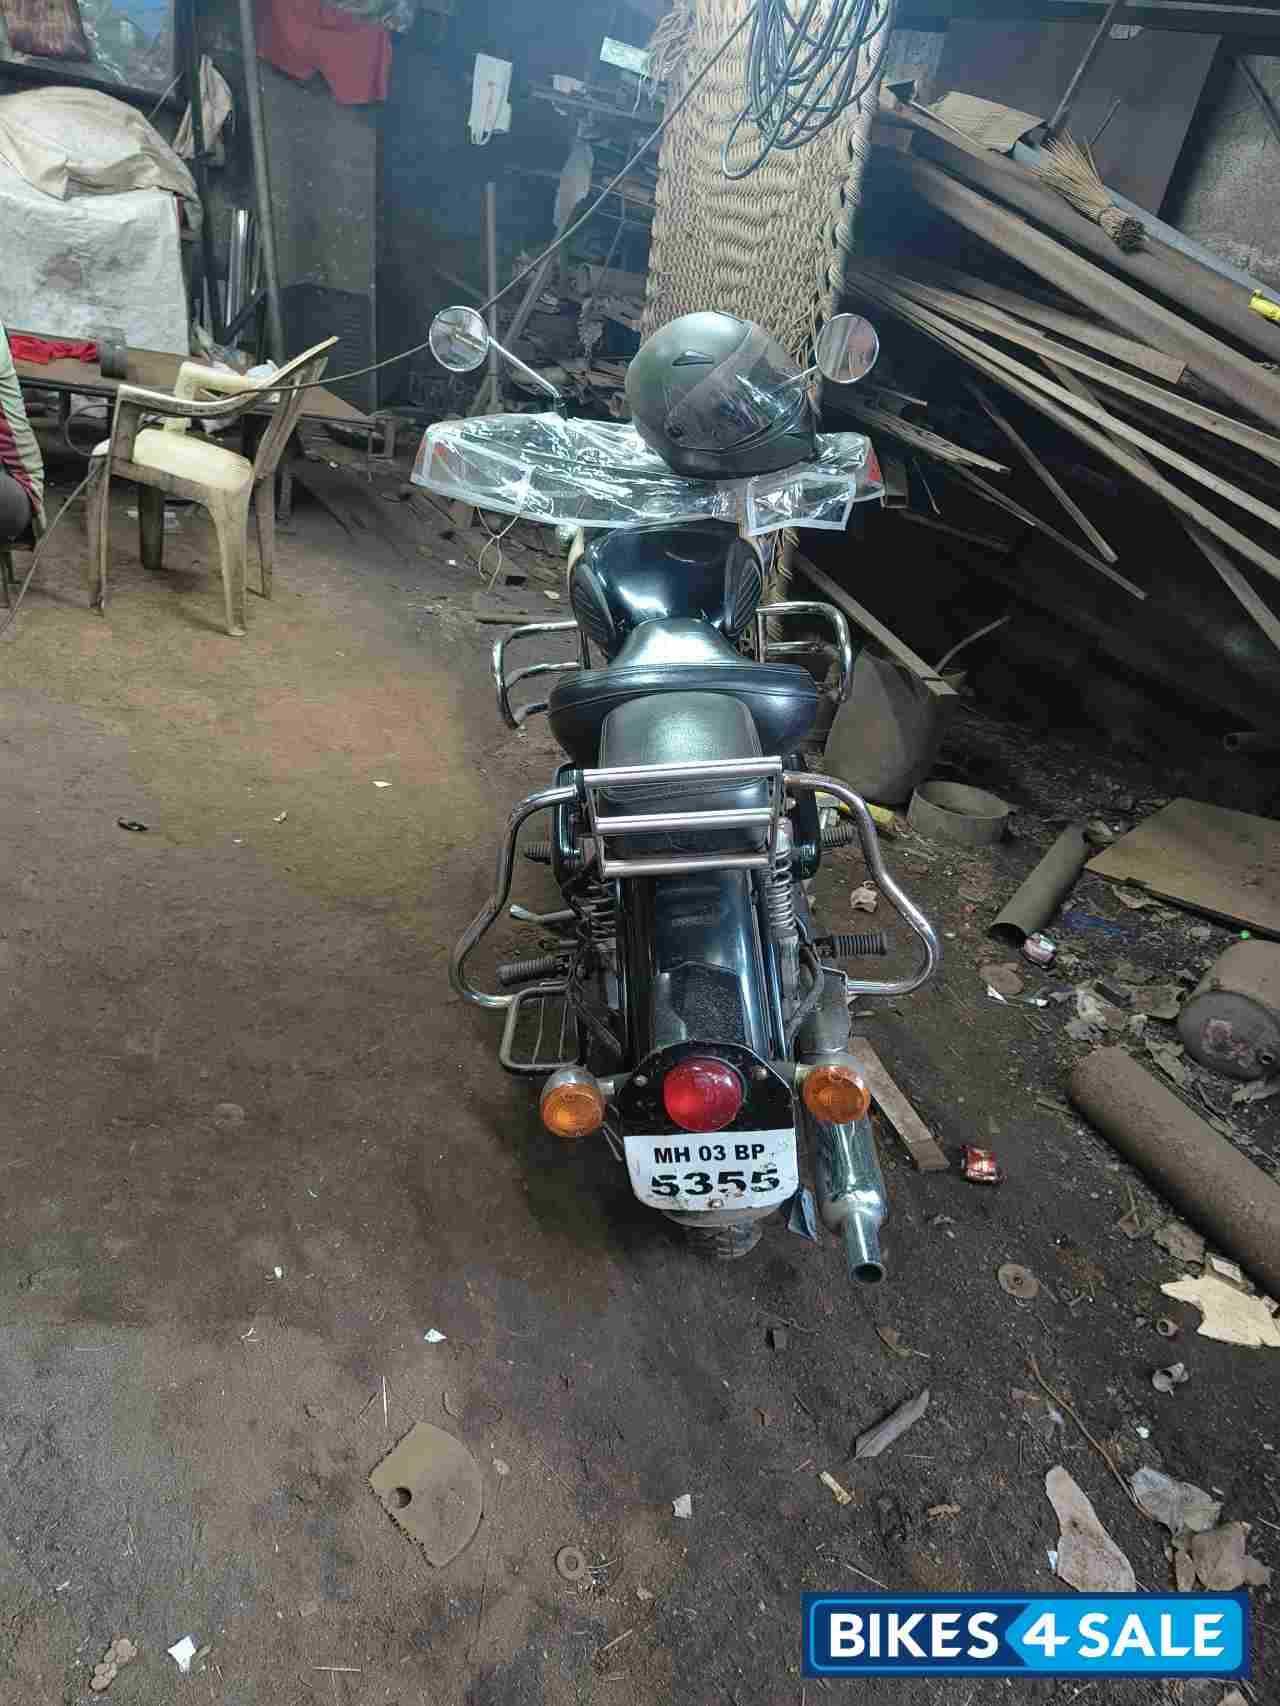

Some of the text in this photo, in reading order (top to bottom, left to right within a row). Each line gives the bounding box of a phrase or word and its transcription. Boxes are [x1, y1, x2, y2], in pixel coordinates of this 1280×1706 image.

[654, 1144, 765, 1163] MH 03 BP
[651, 1169, 780, 1197] 5355
